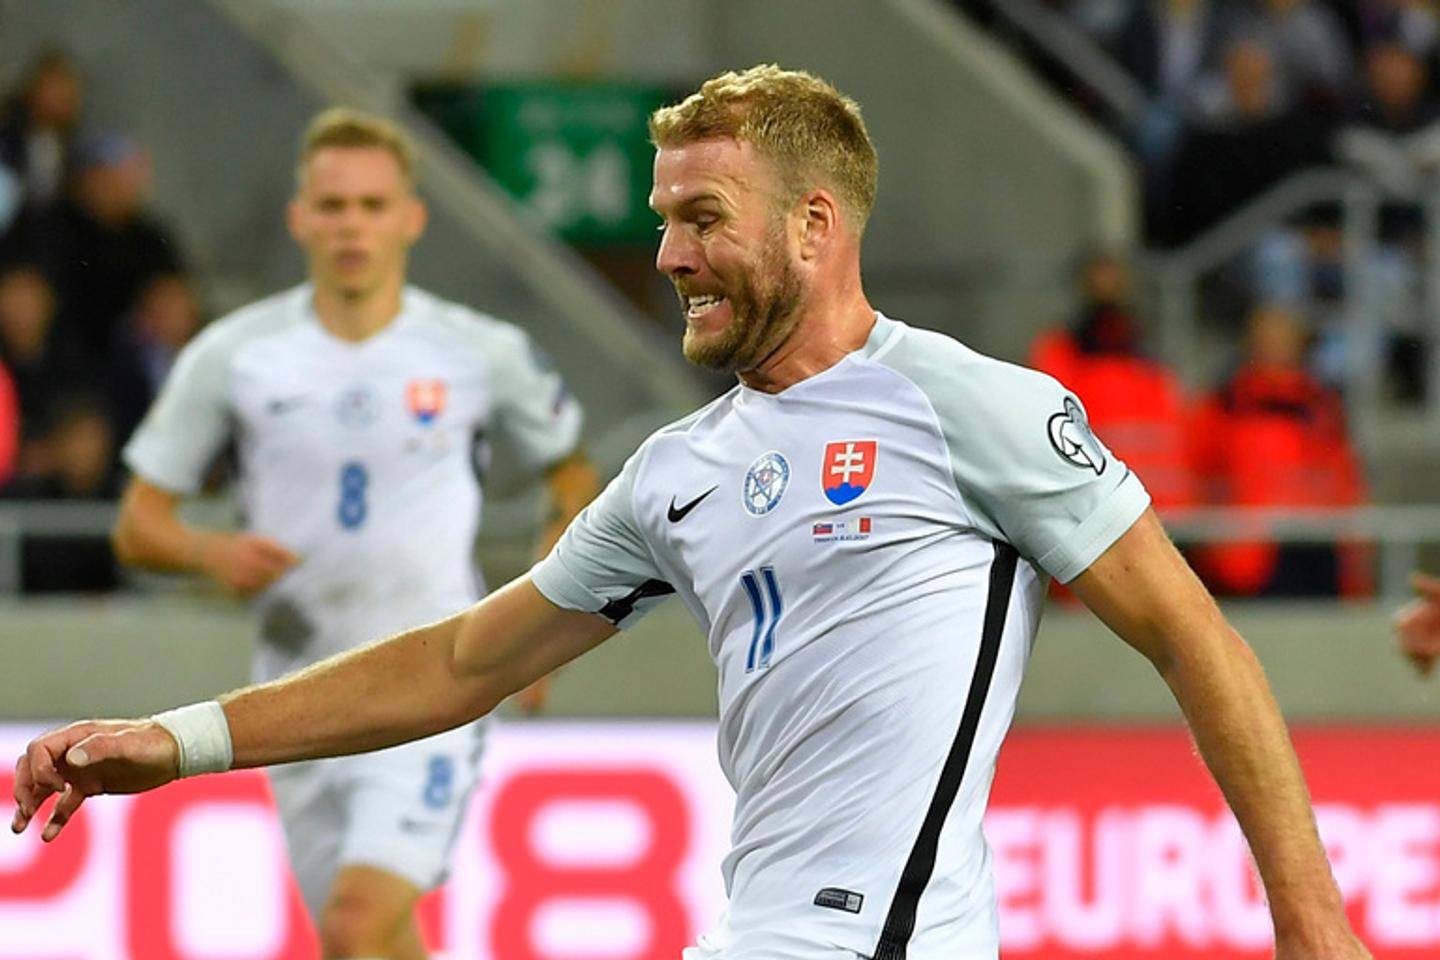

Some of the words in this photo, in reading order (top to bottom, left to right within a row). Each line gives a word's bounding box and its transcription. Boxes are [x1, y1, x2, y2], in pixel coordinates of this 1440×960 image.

[338, 461, 369, 531] 8
[741, 565, 782, 674] 11
[424, 754, 453, 809] 8
